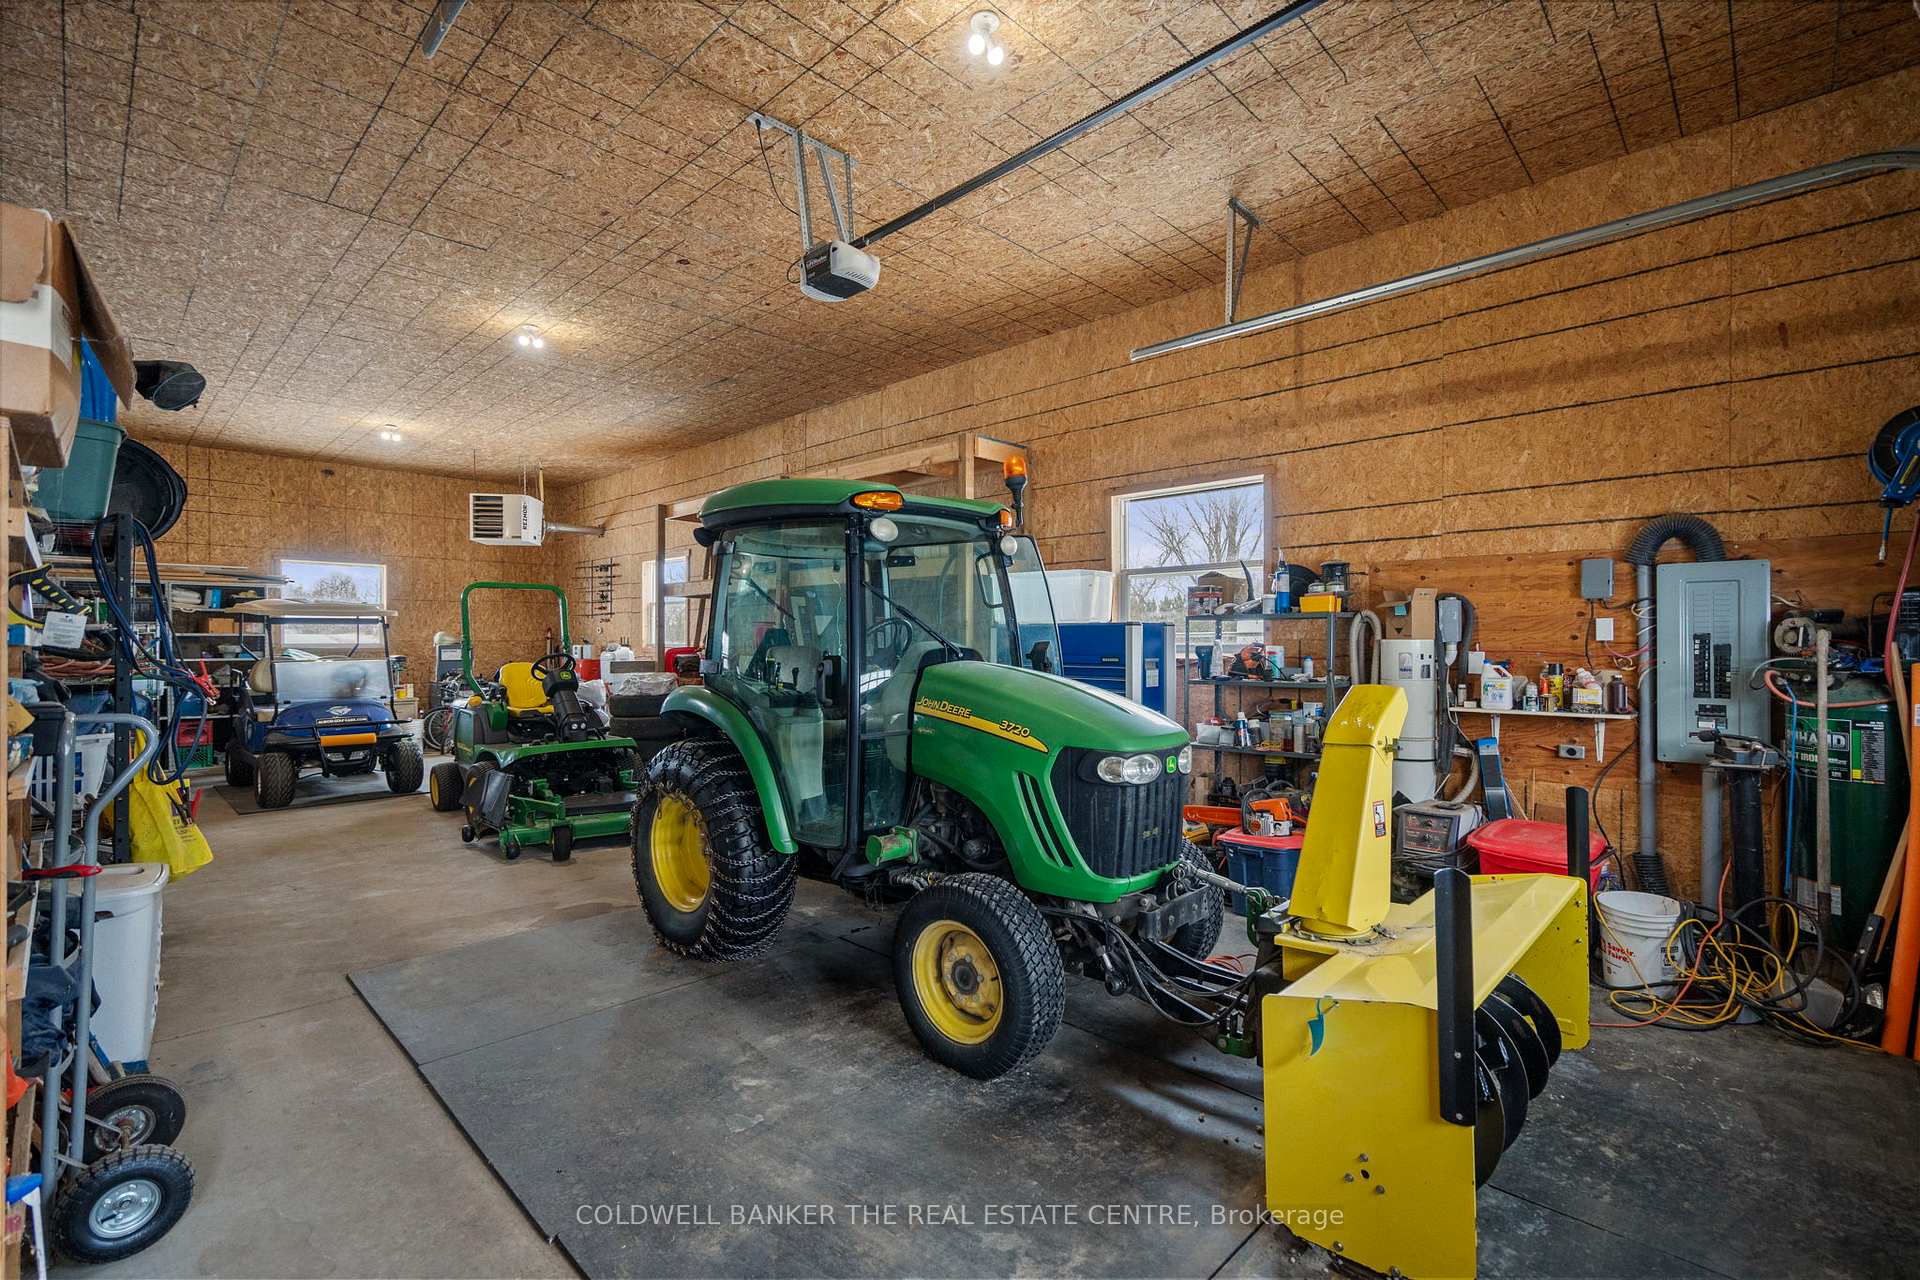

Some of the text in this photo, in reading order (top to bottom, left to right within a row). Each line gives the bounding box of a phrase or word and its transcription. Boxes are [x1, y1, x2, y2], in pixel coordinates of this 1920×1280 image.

[917, 696, 973, 718] JOHN DEERE
[999, 720, 1030, 737] 3720
